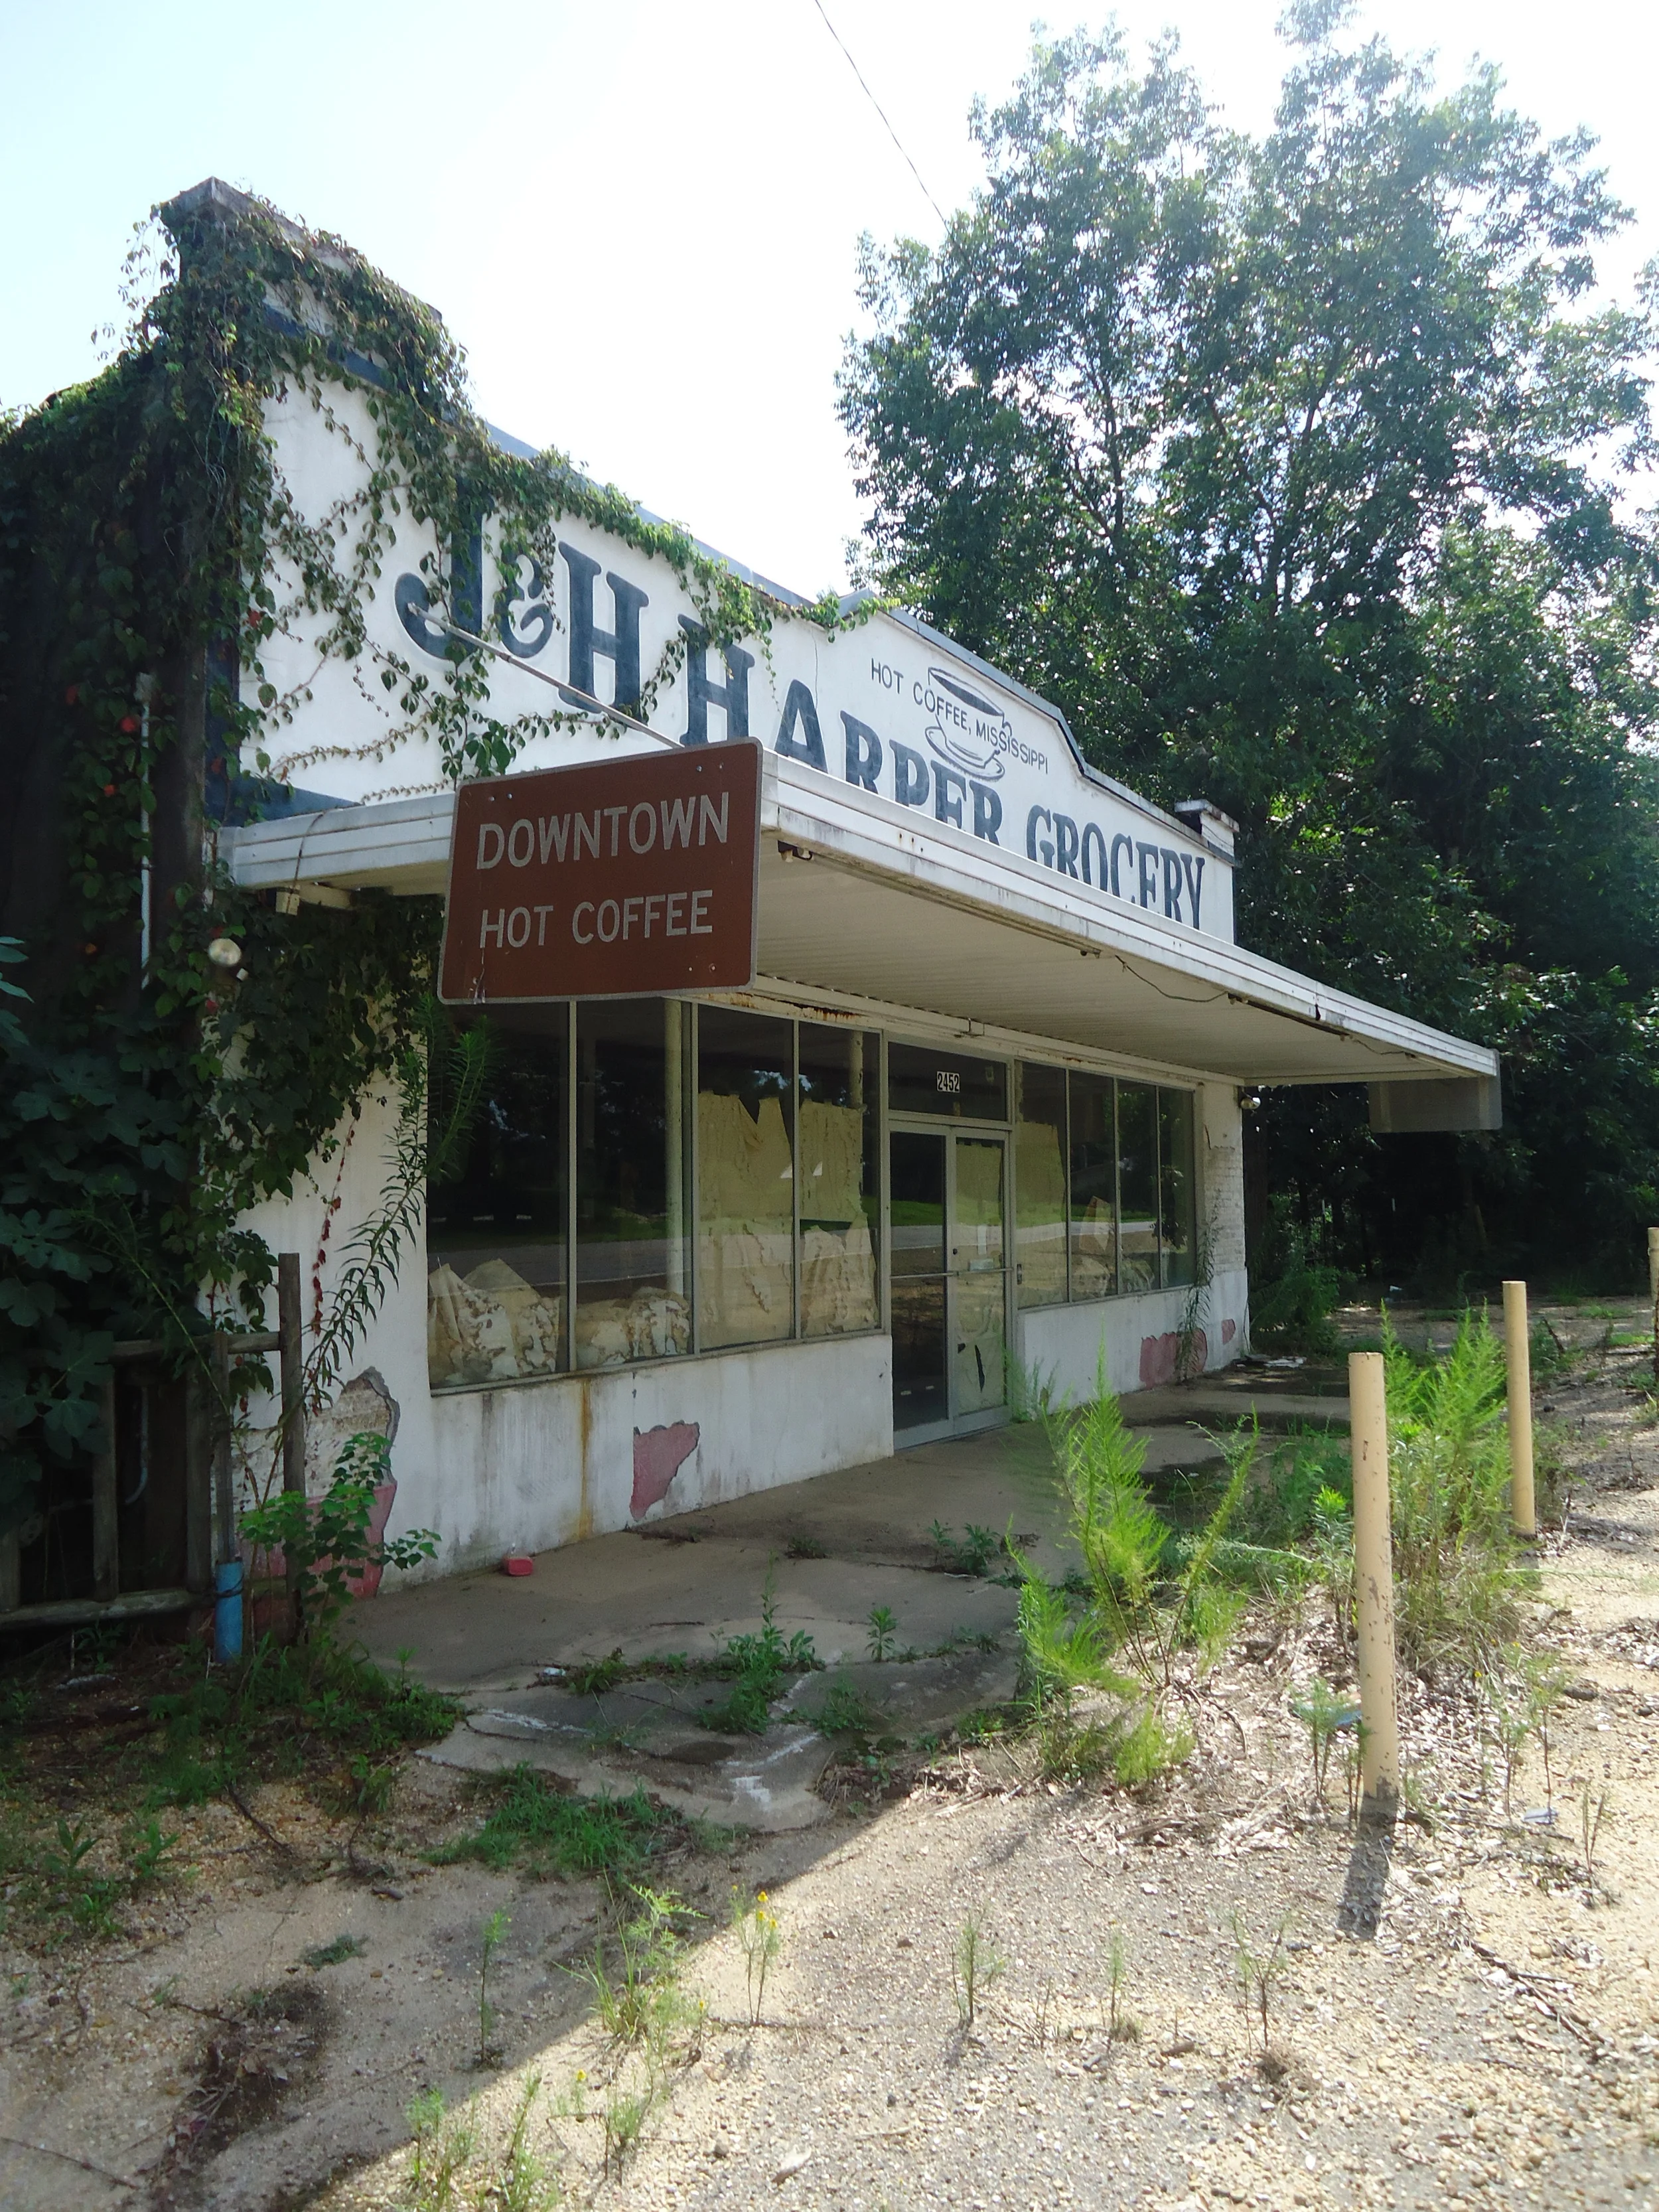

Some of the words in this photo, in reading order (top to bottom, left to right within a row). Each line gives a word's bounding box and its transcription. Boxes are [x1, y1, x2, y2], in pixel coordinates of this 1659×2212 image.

[871, 658, 904, 694] HOT
[913, 682, 972, 735] COFFEE,
[976, 719, 1048, 774] MISSISSIPPI
[678, 613, 1003, 847] HARPER
[1026, 804, 1205, 929] GROCERY
[476, 792, 729, 869] DOWNTOWN
[480, 905, 553, 948] HOT
[572, 889, 713, 945] COFFEE
[938, 1072, 959, 1091] 2452
